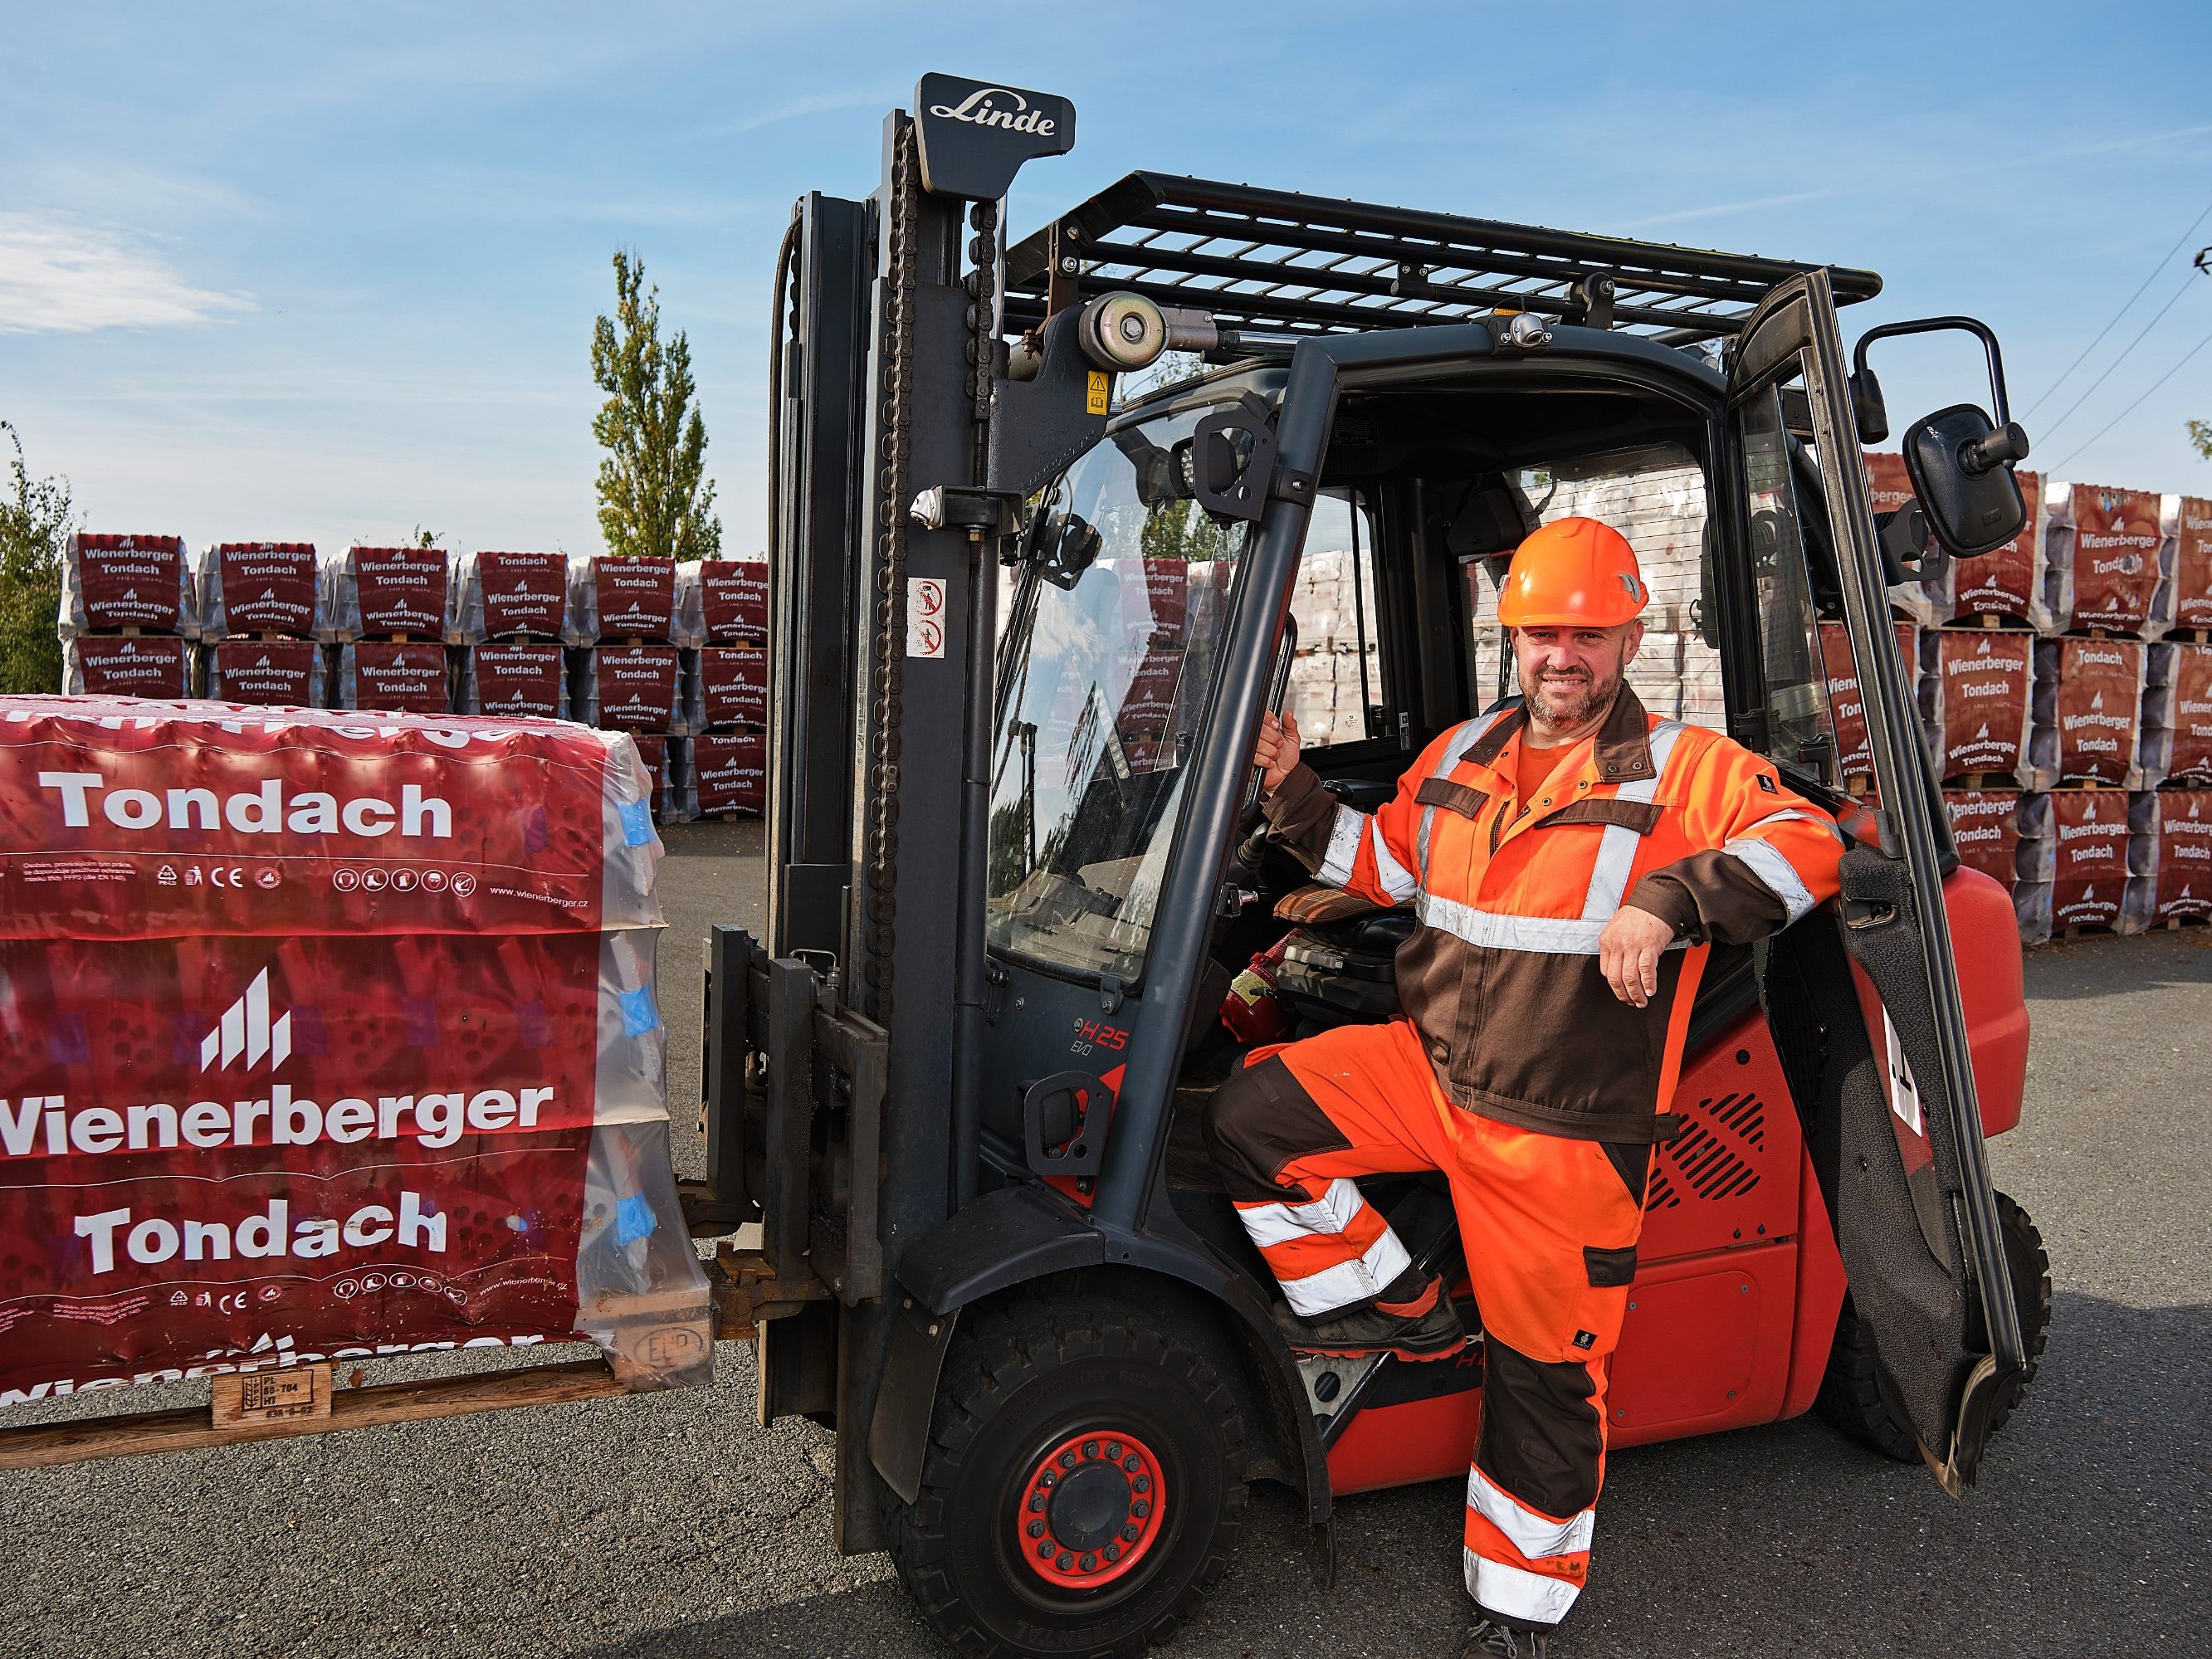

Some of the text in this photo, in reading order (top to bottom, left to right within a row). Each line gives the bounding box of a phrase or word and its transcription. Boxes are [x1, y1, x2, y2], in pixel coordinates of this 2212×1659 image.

[930, 88, 1055, 136] Linde
[2081, 534, 2157, 549] Wienerberger
[85, 549, 174, 562] Wienerberger
[226, 549, 311, 562] Wienerberger
[498, 556, 548, 566] Tondach
[101, 564, 159, 574] Tondach
[242, 565, 297, 575] Tondach
[361, 561, 442, 573] Wienerberger
[600, 564, 671, 574] Wienerberger
[375, 575, 427, 585] Tondach
[613, 578, 658, 588] Tondach
[707, 578, 768, 589] Wienerberge
[719, 592, 761, 602] Tondach
[1135, 587, 1174, 595] Tondach
[1960, 588, 2025, 606] Wienerberger
[488, 593, 560, 605] Wienerberger
[90, 600, 174, 616] Wienerberger
[230, 599, 310, 616] Wienerberger
[501, 606, 547, 617] Tondach
[106, 610, 159, 621] Tondach
[246, 612, 295, 623] Tondach
[367, 609, 439, 624] Wienerberger
[603, 612, 667, 623] Wienerberger
[380, 620, 426, 628] Tondach
[85, 653, 177, 668] Wienerberger
[480, 651, 556, 662] Wienerberger
[603, 656, 672, 666] Wienerberger
[719, 651, 762, 660] Tondach
[2078, 649, 2122, 665] Tondach
[362, 666, 442, 678] Wienerberger
[494, 666, 542, 676] Tondach
[1130, 667, 1169, 677] Tondach
[1948, 656, 2024, 676] Wienerberger
[104, 668, 162, 680] Tondach
[225, 667, 305, 680] Wienerberger
[614, 670, 659, 680] Tondach
[239, 681, 291, 691] Tondach
[377, 682, 427, 693] Tondach
[709, 683, 768, 694] Wienerberge
[1962, 681, 2009, 698] Tondach
[485, 700, 554, 712] Wienerberger
[720, 696, 762, 705] Tondach
[603, 704, 668, 715] Wienerberger
[616, 714, 656, 722] Tondach
[2063, 712, 2131, 731] Wienerberger
[710, 736, 755, 745] Tondach
[2077, 737, 2117, 752] Tondach
[1949, 740, 2016, 759] Wienerberger
[1962, 754, 2004, 767] Tondach
[701, 768, 764, 780] Wienerberger
[713, 780, 752, 791] Tondach
[39, 771, 452, 838] Tondach
[2059, 822, 2126, 841] Wienerberger
[2164, 819, 2212, 835] Wienerberg
[1954, 825, 2001, 844] Tondach
[2071, 844, 2113, 862] Tondach
[2174, 844, 2211, 860] Tondach
[211, 866, 243, 888] CE
[490, 887, 588, 908] www.wienerberger.cz
[2058, 901, 2118, 916] Wienerberger
[1071, 1041, 1092, 1056] EVO
[75, 1191, 447, 1275] Tondach
[263, 1383, 297, 1395] 80-704
[264, 1397, 276, 1406] HT
